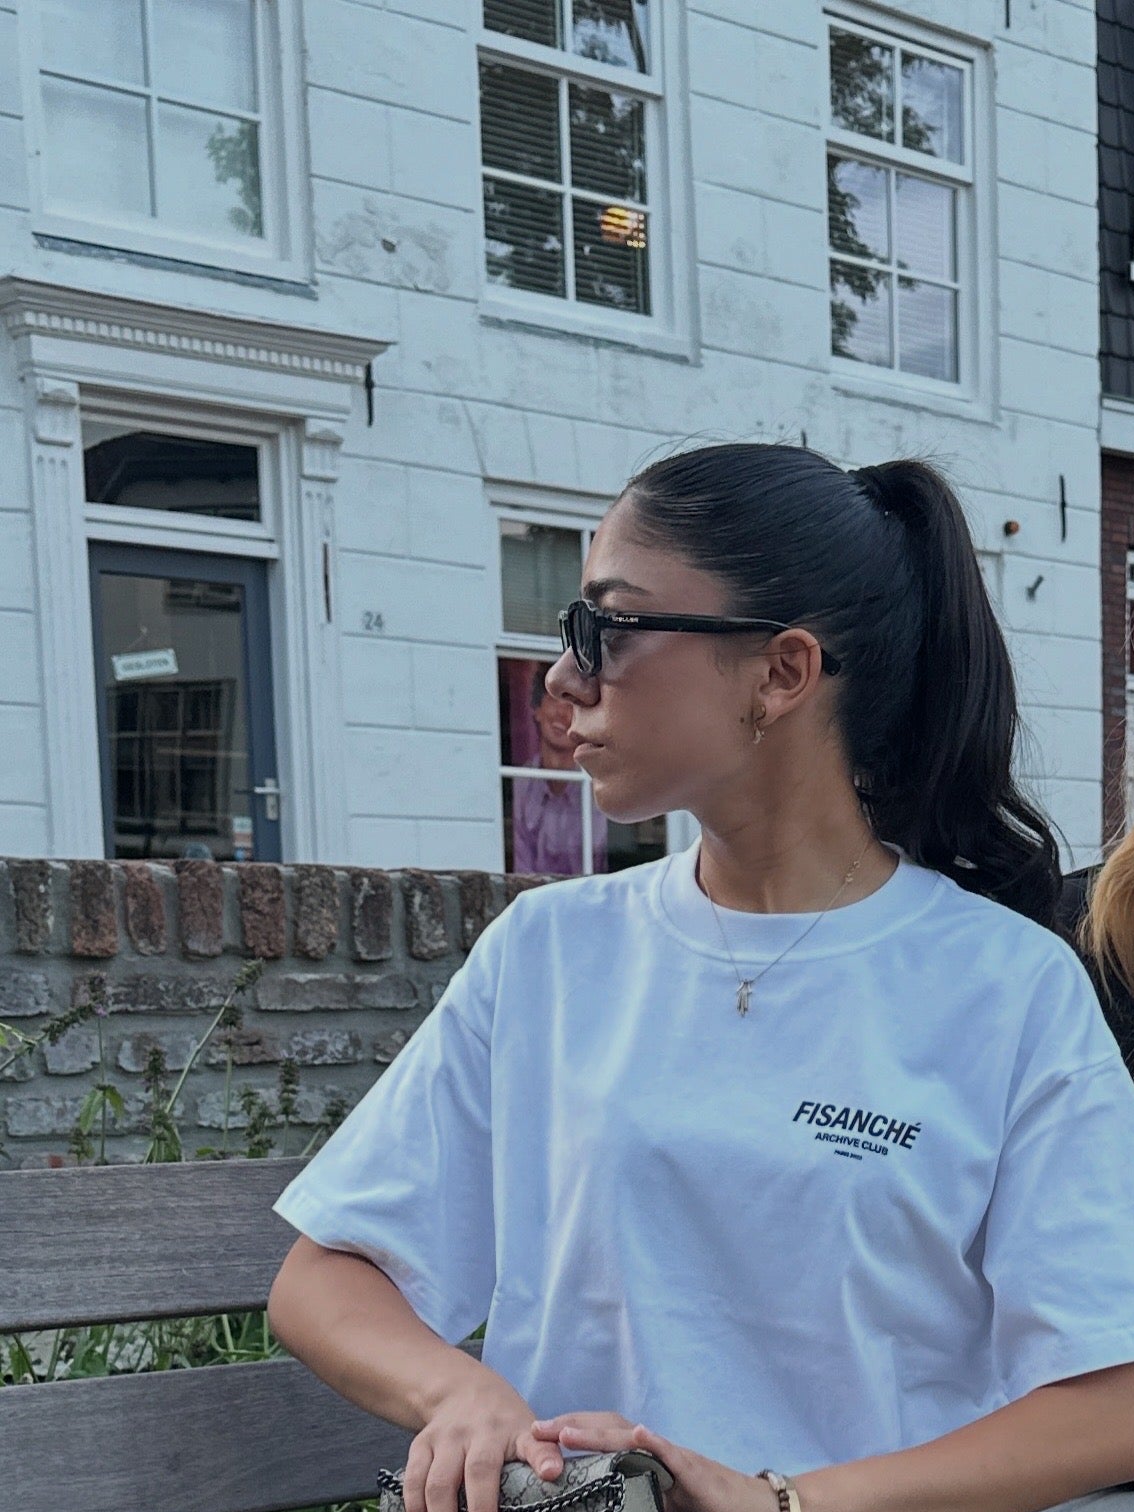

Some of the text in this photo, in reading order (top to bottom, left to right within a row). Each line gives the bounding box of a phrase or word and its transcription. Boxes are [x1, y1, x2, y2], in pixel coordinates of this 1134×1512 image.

[792, 1101, 922, 1150] FISANCHÉ
[815, 1132, 889, 1156] ARCHIVE CLUB
